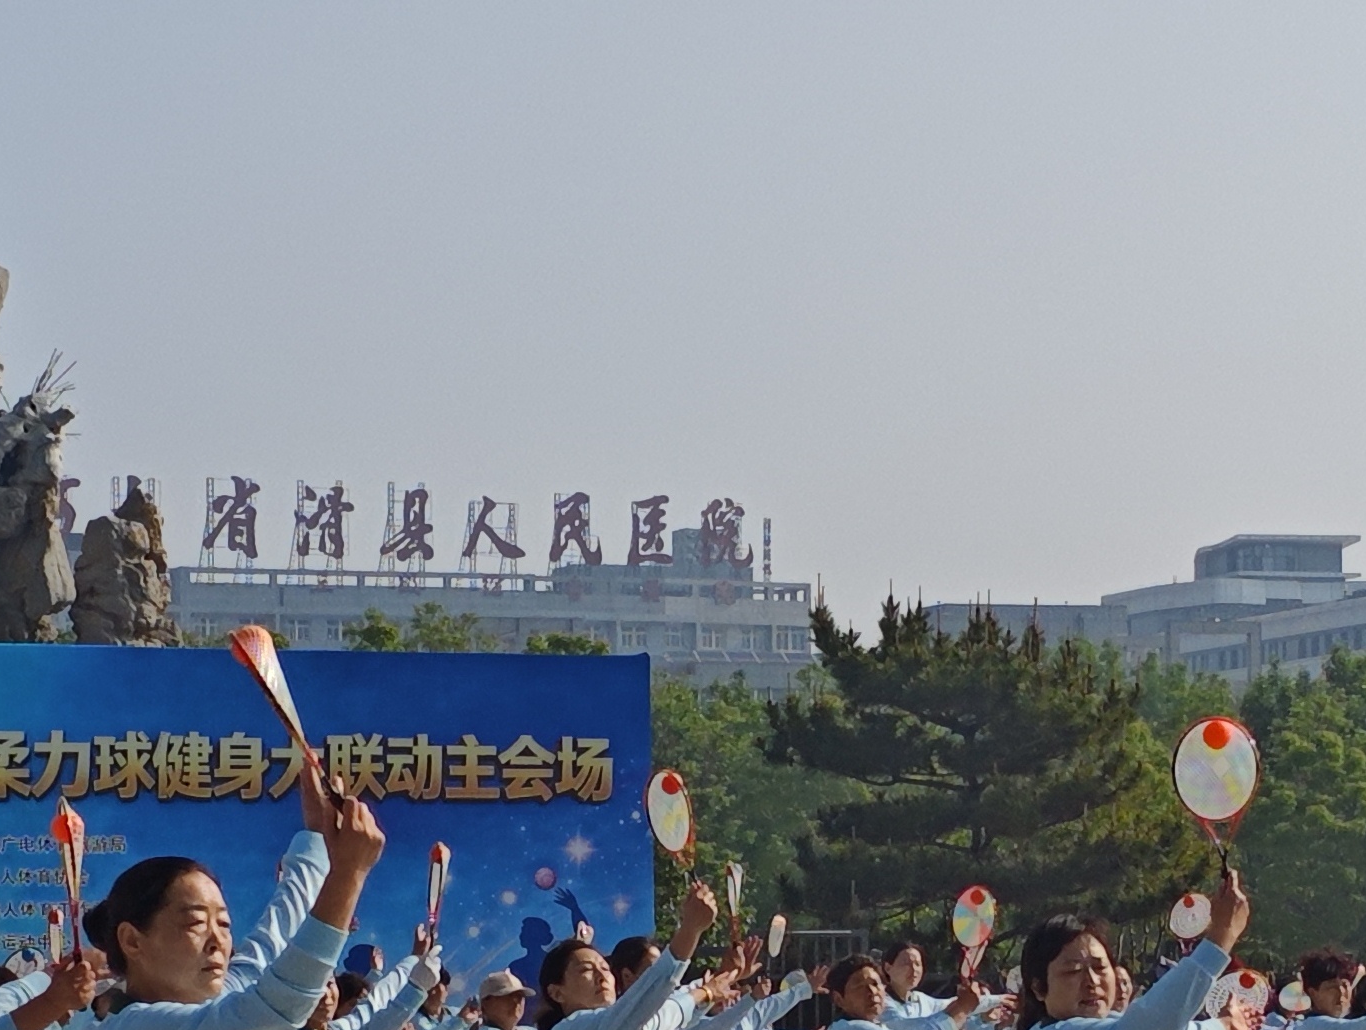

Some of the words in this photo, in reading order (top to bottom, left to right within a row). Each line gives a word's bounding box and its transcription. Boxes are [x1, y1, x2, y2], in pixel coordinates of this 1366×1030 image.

[59, 475, 754, 568] 省滑县人民医院
